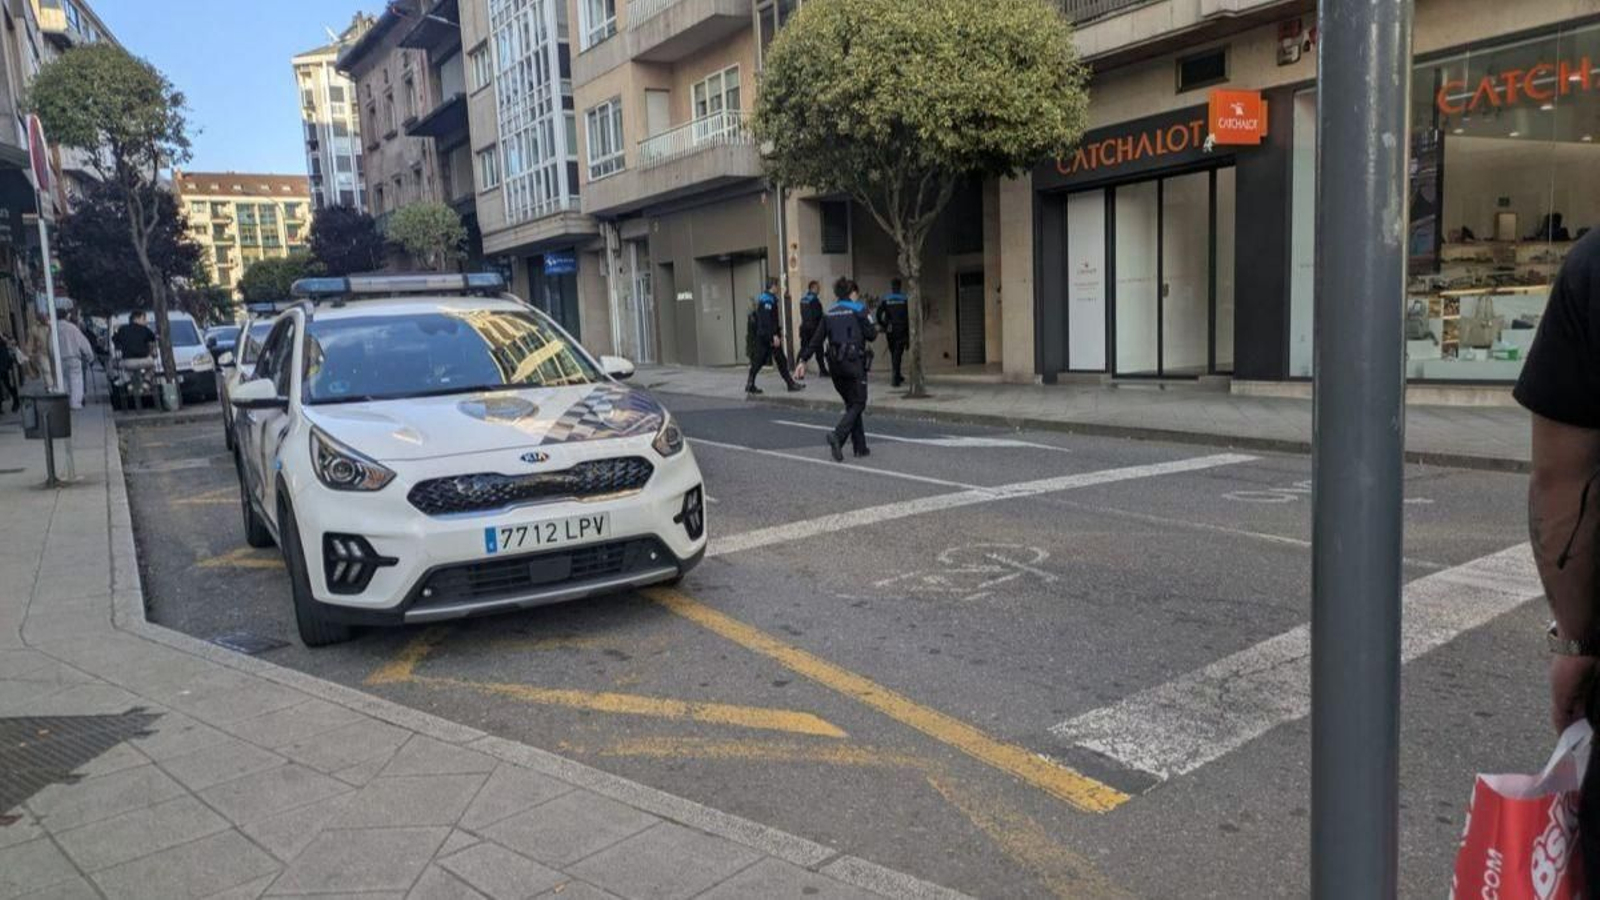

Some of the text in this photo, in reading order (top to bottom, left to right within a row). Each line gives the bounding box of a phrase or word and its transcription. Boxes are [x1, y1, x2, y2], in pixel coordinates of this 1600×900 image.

[1438, 55, 1600, 114] CATCH
[1217, 118, 1259, 130] CATCHALOT
[1056, 120, 1204, 175] CATCHALOT
[521, 452, 549, 463] KIA
[501, 515, 604, 550] 7712 LPV
